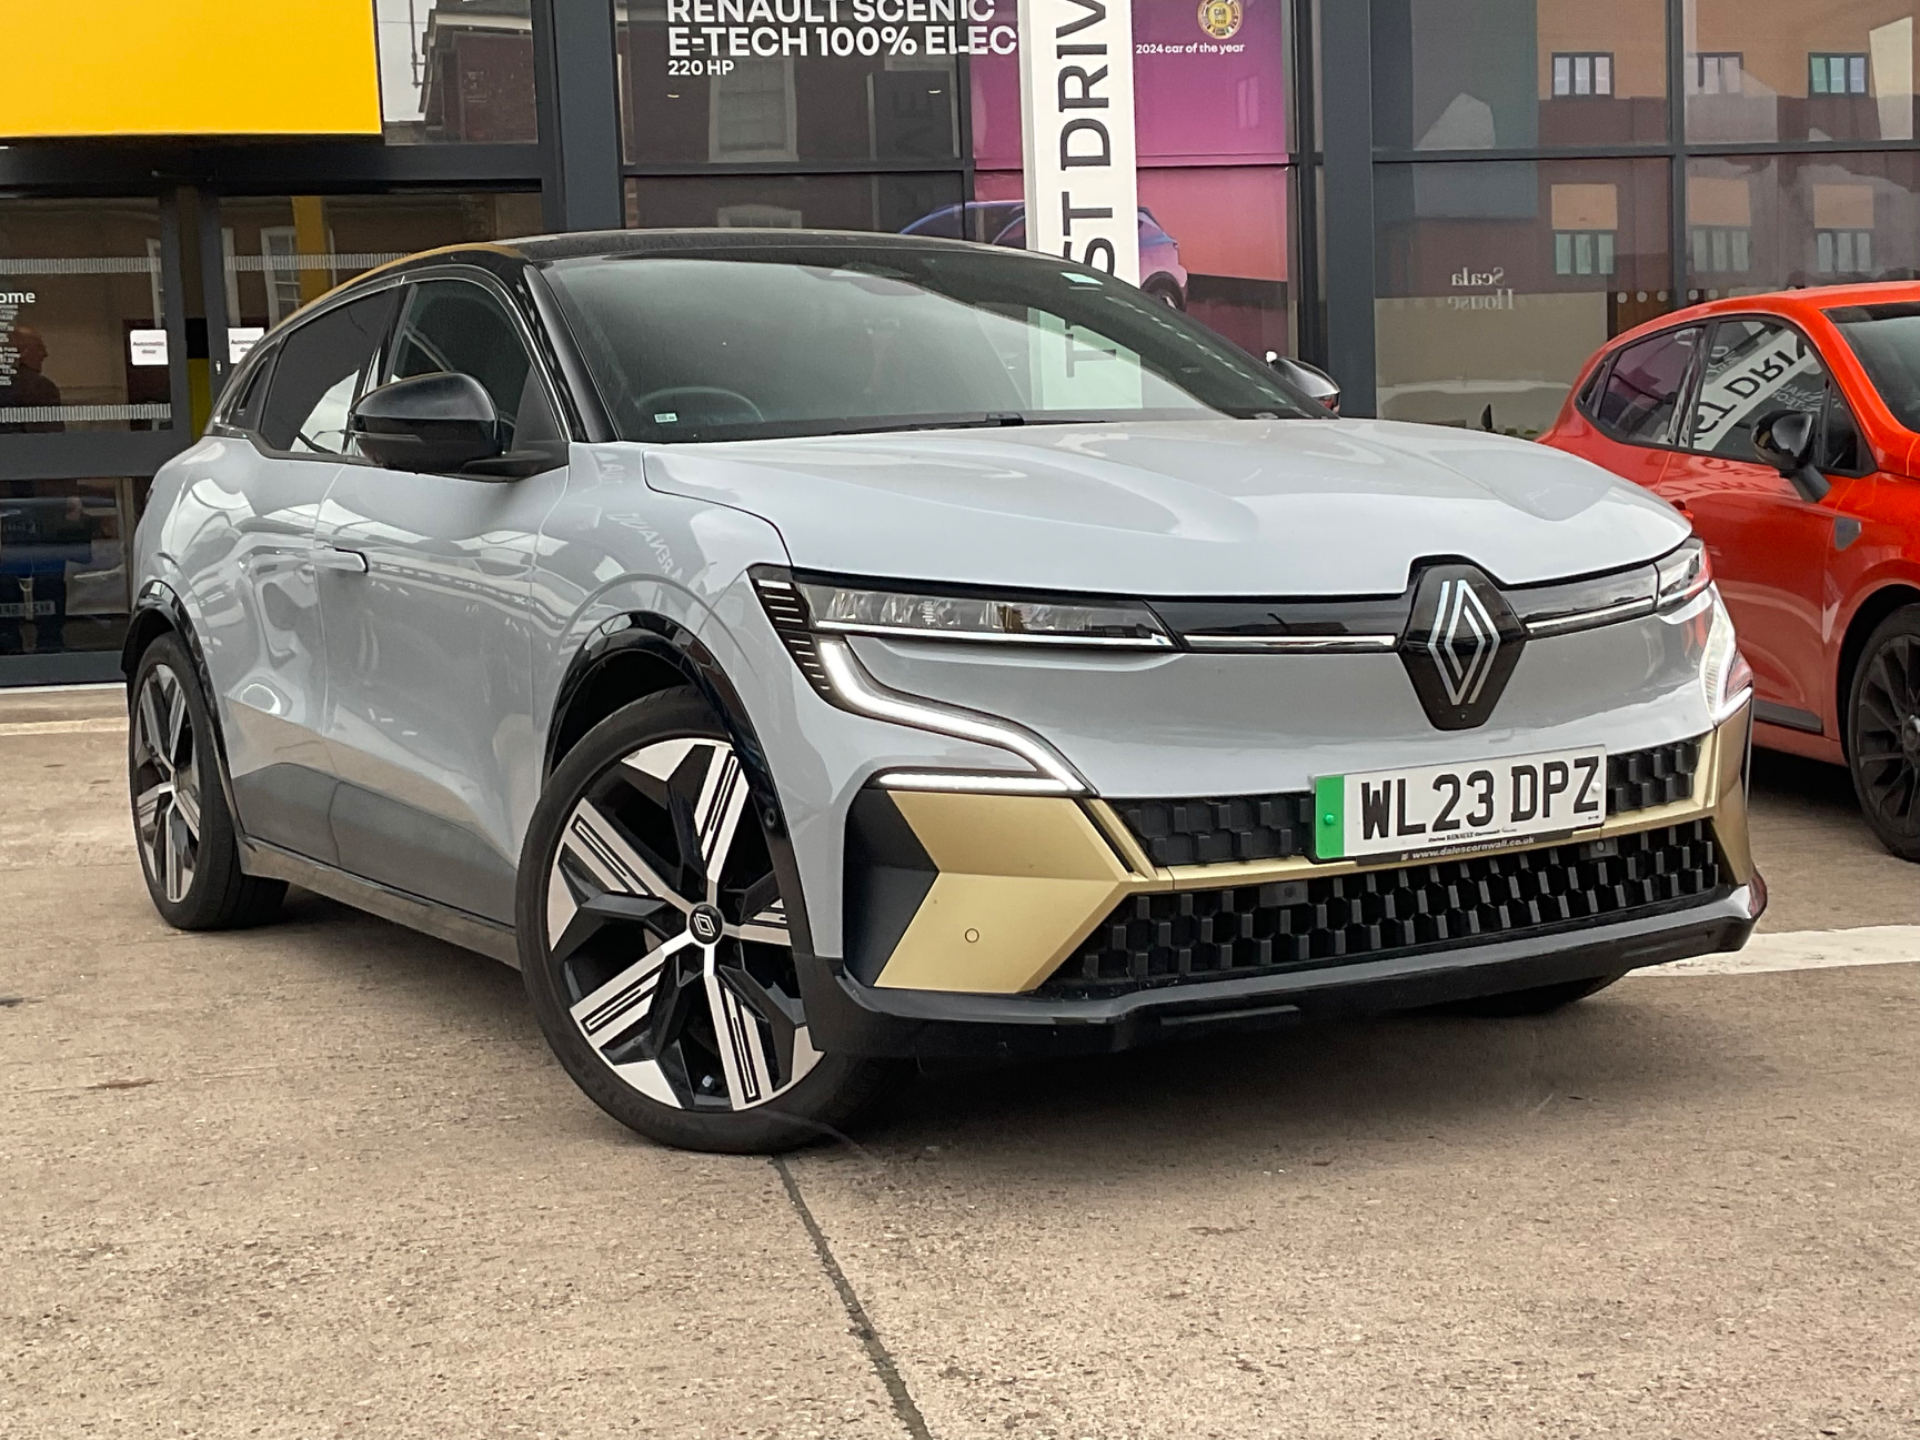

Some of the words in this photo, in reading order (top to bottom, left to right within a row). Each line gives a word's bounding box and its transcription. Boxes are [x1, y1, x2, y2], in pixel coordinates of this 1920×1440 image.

[667, 0, 846, 23] RENAULT
[668, 27, 807, 57] E-TECH
[815, 26, 917, 56] 100%
[925, 25, 1017, 55] ELEC
[1136, 43, 1164, 54] 2024
[1165, 45, 1183, 53] car
[1185, 43, 1198, 54] of
[1199, 42, 1218, 53] the
[1219, 44, 1245, 55] year
[668, 60, 703, 75] 220
[707, 60, 734, 75] HP
[1361, 769, 1494, 840] WL23
[1510, 756, 1599, 823] DPZ
